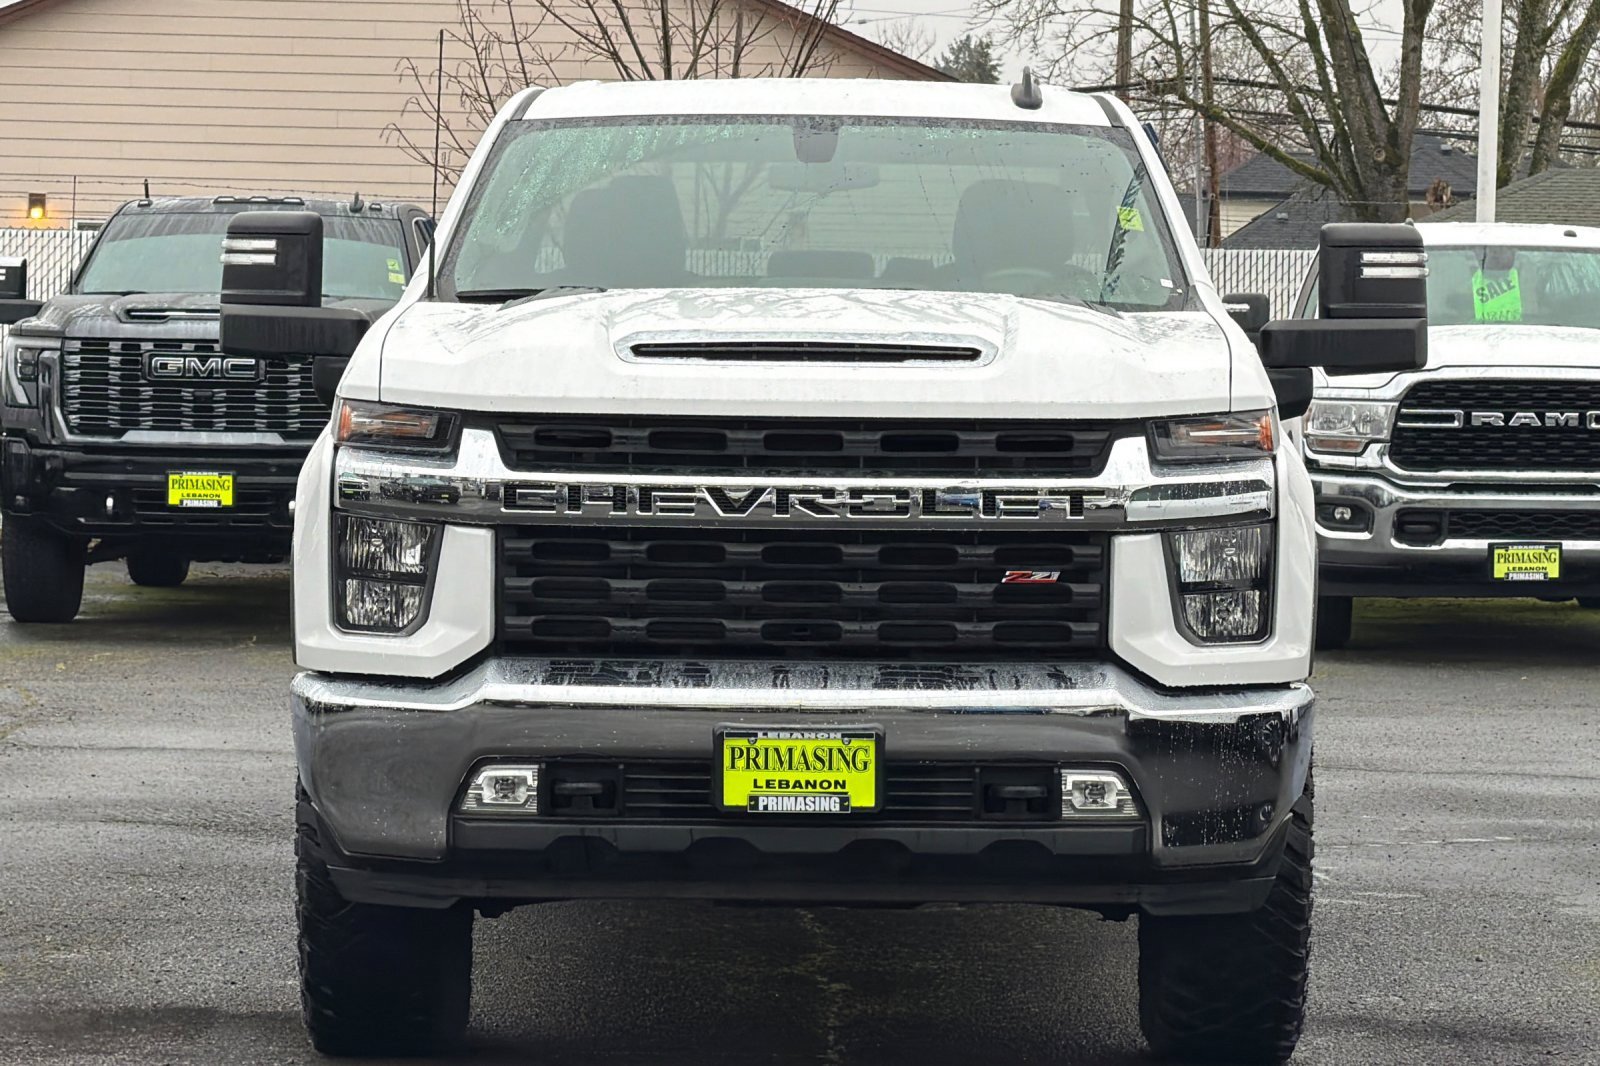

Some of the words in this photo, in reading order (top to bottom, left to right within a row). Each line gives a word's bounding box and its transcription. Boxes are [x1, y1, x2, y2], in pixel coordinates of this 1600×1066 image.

[1475, 279, 1516, 304] SALE
[152, 357, 255, 377] GMC
[1471, 412, 1579, 427] RAM
[171, 478, 231, 491] PRIMASING
[500, 484, 1107, 519] CHEVROLET
[1496, 552, 1557, 564] PRIMASING
[1001, 570, 1061, 583] Z71
[757, 731, 842, 740] LEBANON
[726, 745, 871, 773] PRIMASING
[753, 778, 847, 790] LEBANON
[758, 796, 840, 812] PRIMASING
